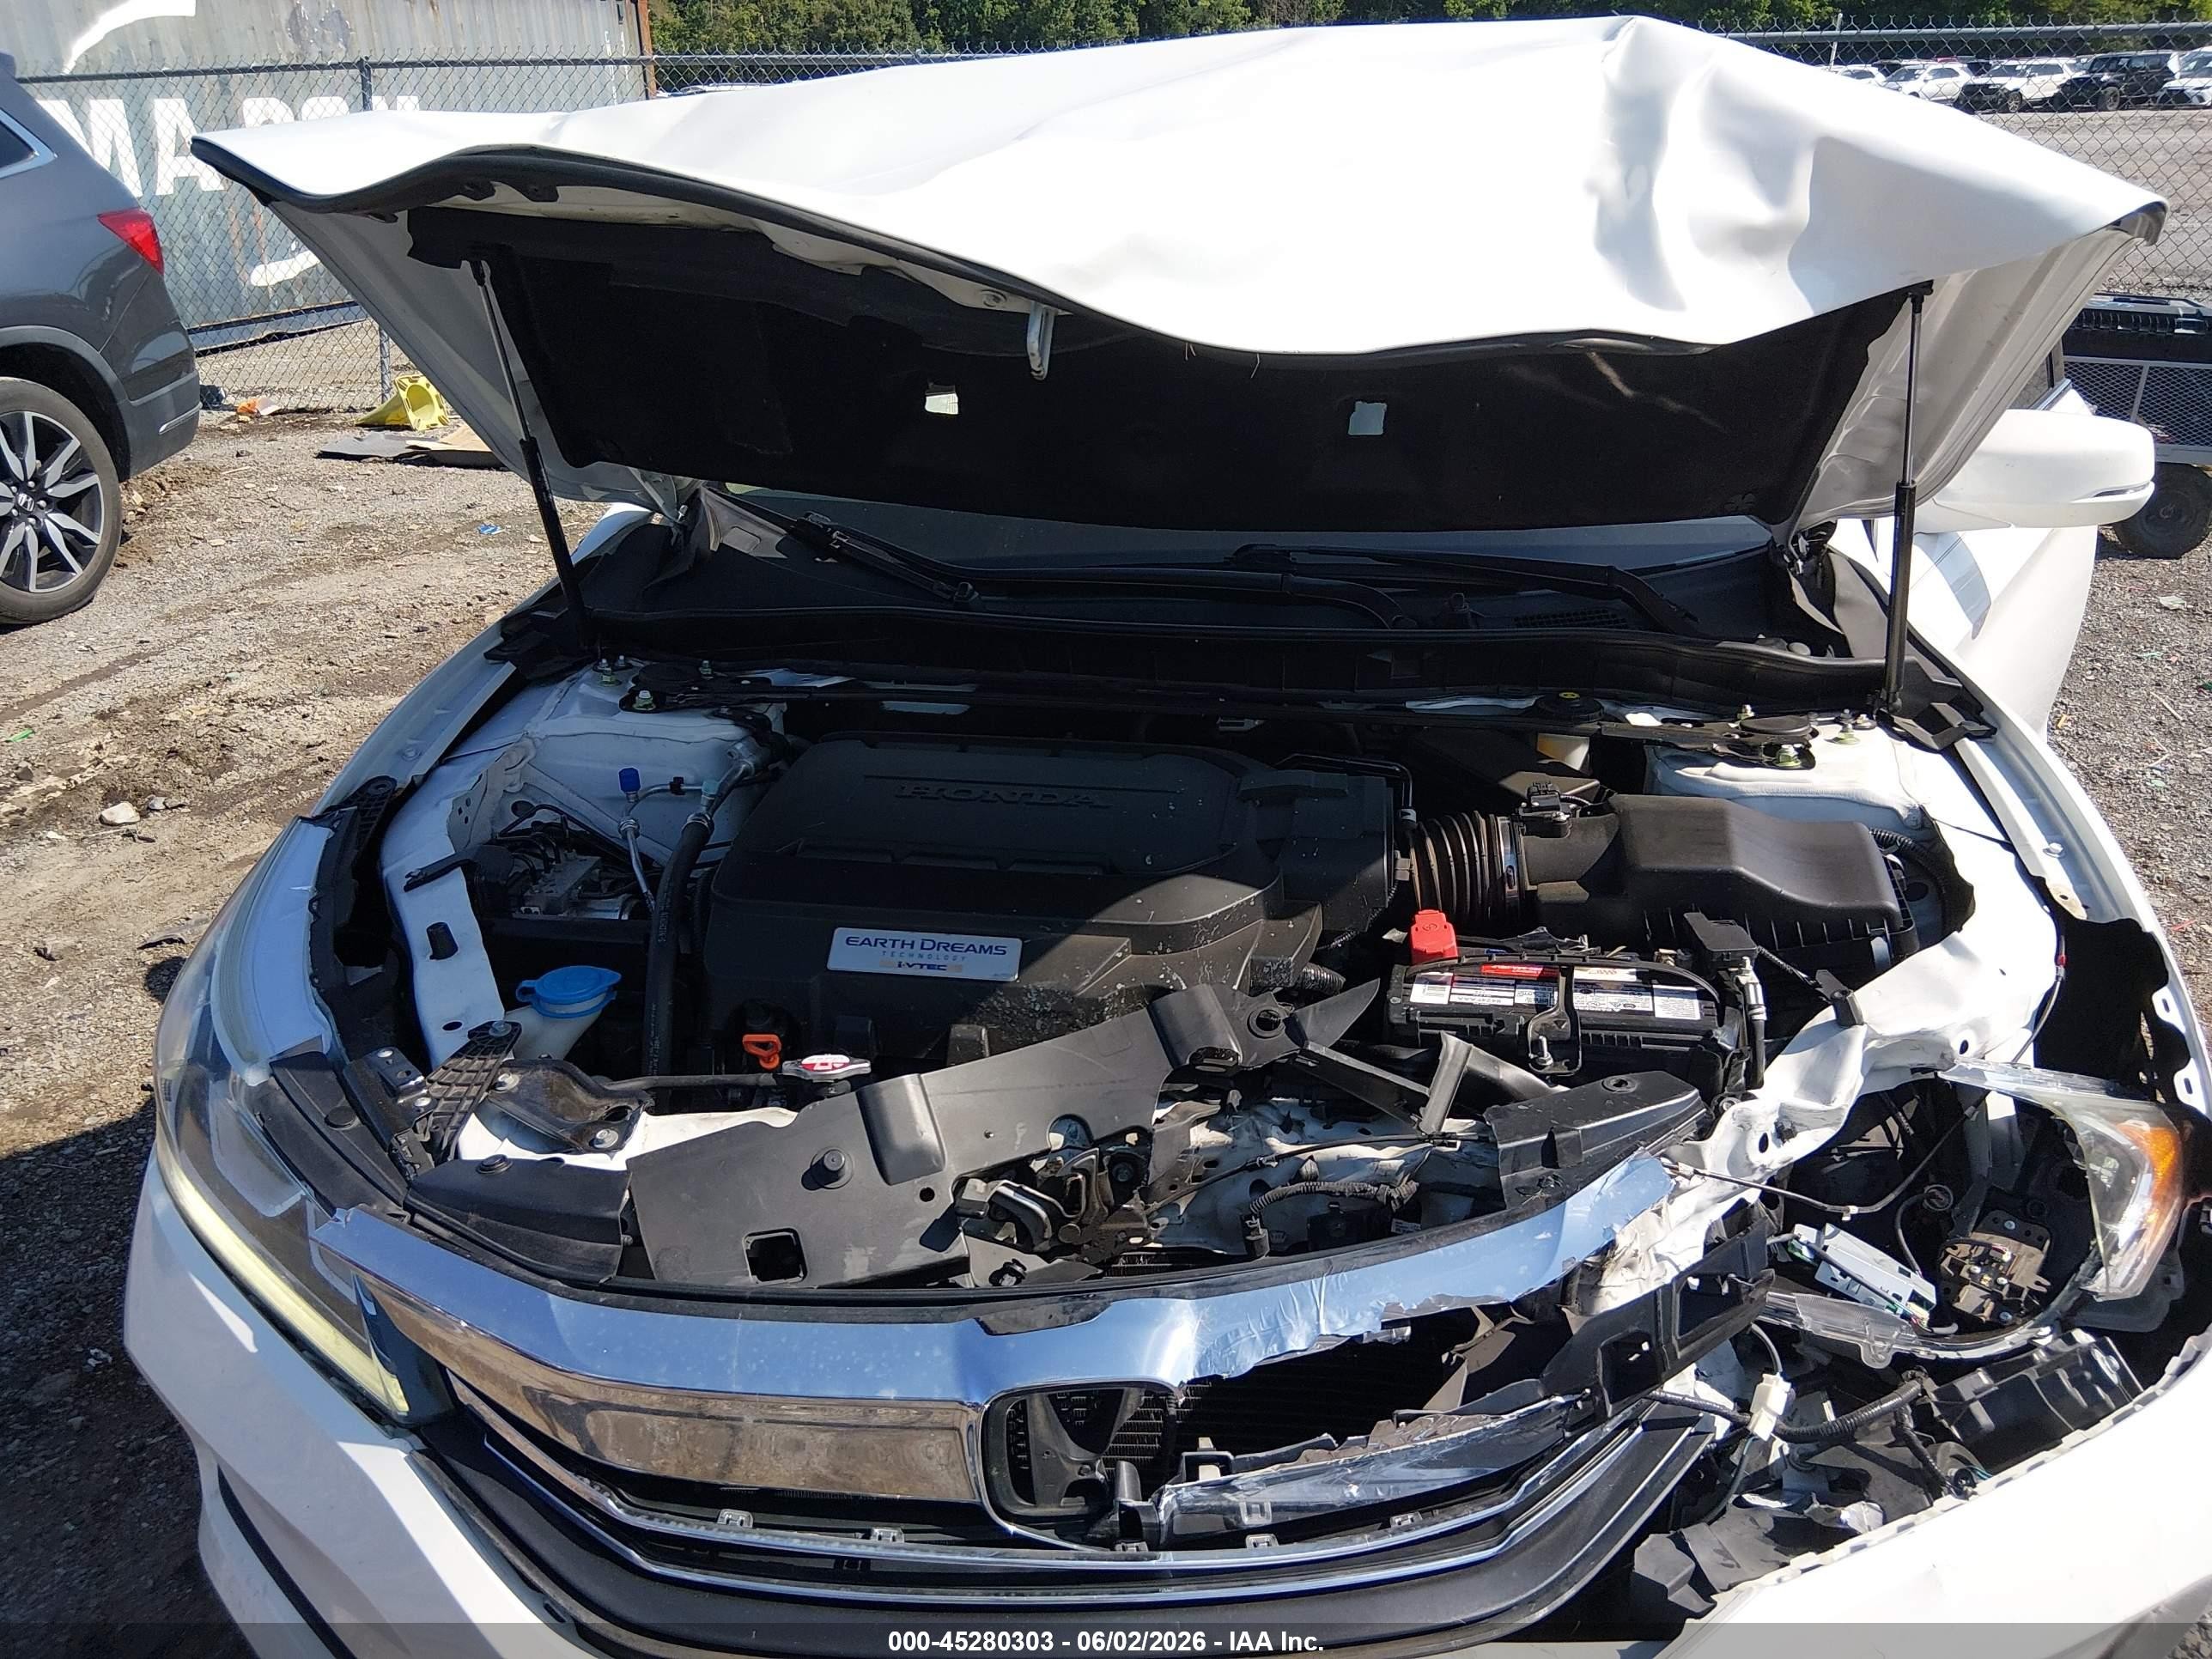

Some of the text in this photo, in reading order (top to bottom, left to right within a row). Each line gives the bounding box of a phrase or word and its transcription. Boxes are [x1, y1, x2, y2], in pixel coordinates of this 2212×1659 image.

[895, 786, 1112, 808] HONDA
[845, 935, 1008, 956] EARTH DREAMS
[882, 951, 967, 962] TECHNOLOGY
